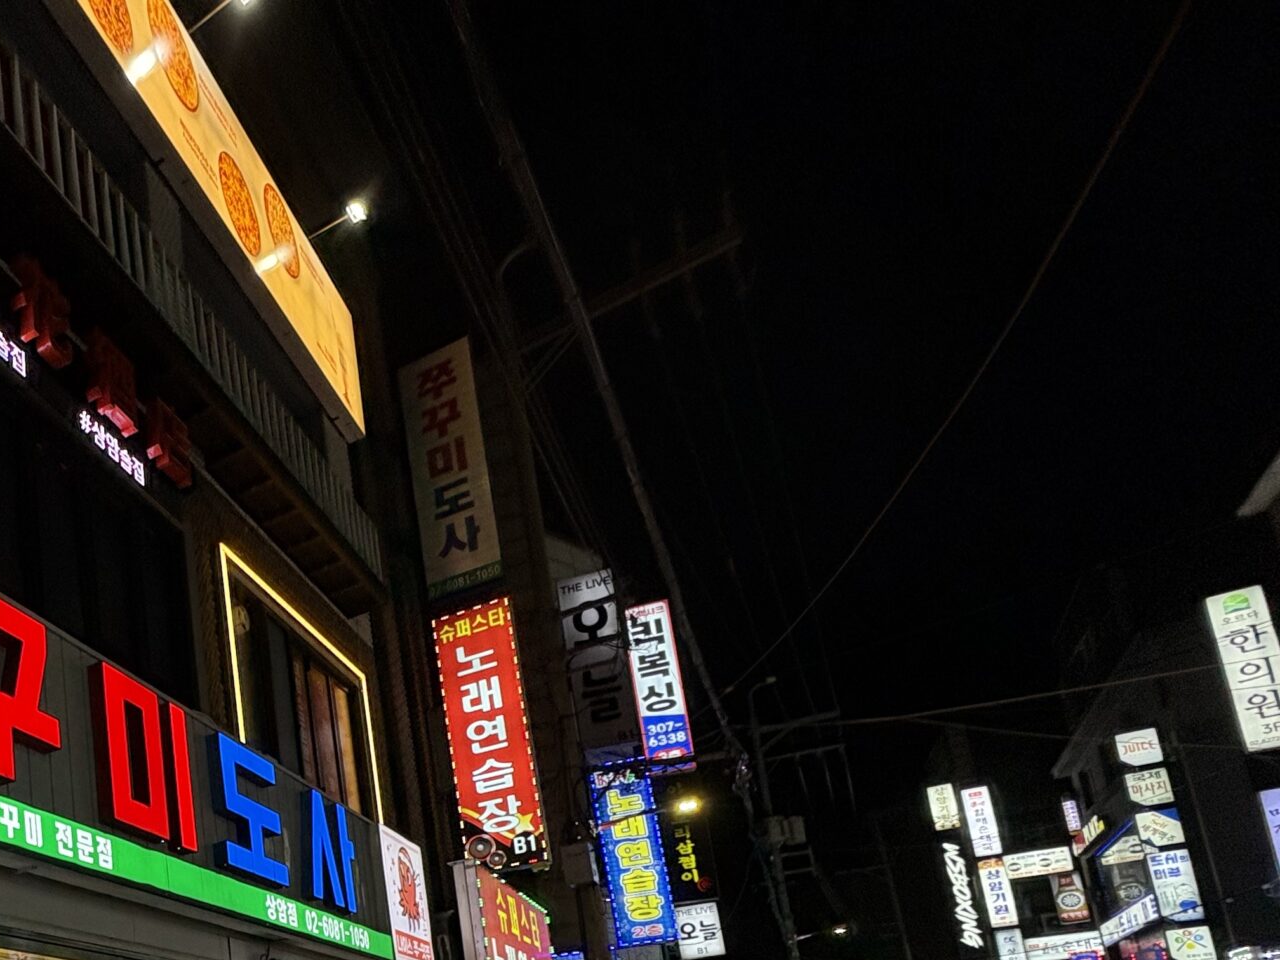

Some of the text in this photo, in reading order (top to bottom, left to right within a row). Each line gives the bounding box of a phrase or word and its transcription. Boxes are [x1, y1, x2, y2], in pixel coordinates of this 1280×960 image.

[560, 581, 583, 595] THE
[439, 609, 505, 644] 슈퍼스타
[1230, 624, 1280, 719] 한의원
[455, 645, 522, 834] 노래연습장
[648, 732, 687, 748] 6338
[1122, 740, 1158, 755] JUICE
[1131, 780, 1170, 797] 마사지
[55, 820, 114, 871] 전문점
[513, 834, 537, 855] B1
[607, 790, 665, 921] 노래연습장
[986, 869, 1010, 916] 상암기원
[265, 893, 298, 928] 상암점
[305, 909, 370, 950] 02-6081-1050
[496, 887, 542, 952] 슈퍼스타
[676, 905, 715, 918] THE LIVE
[679, 920, 720, 941] 오늘
[697, 947, 709, 955] B1
